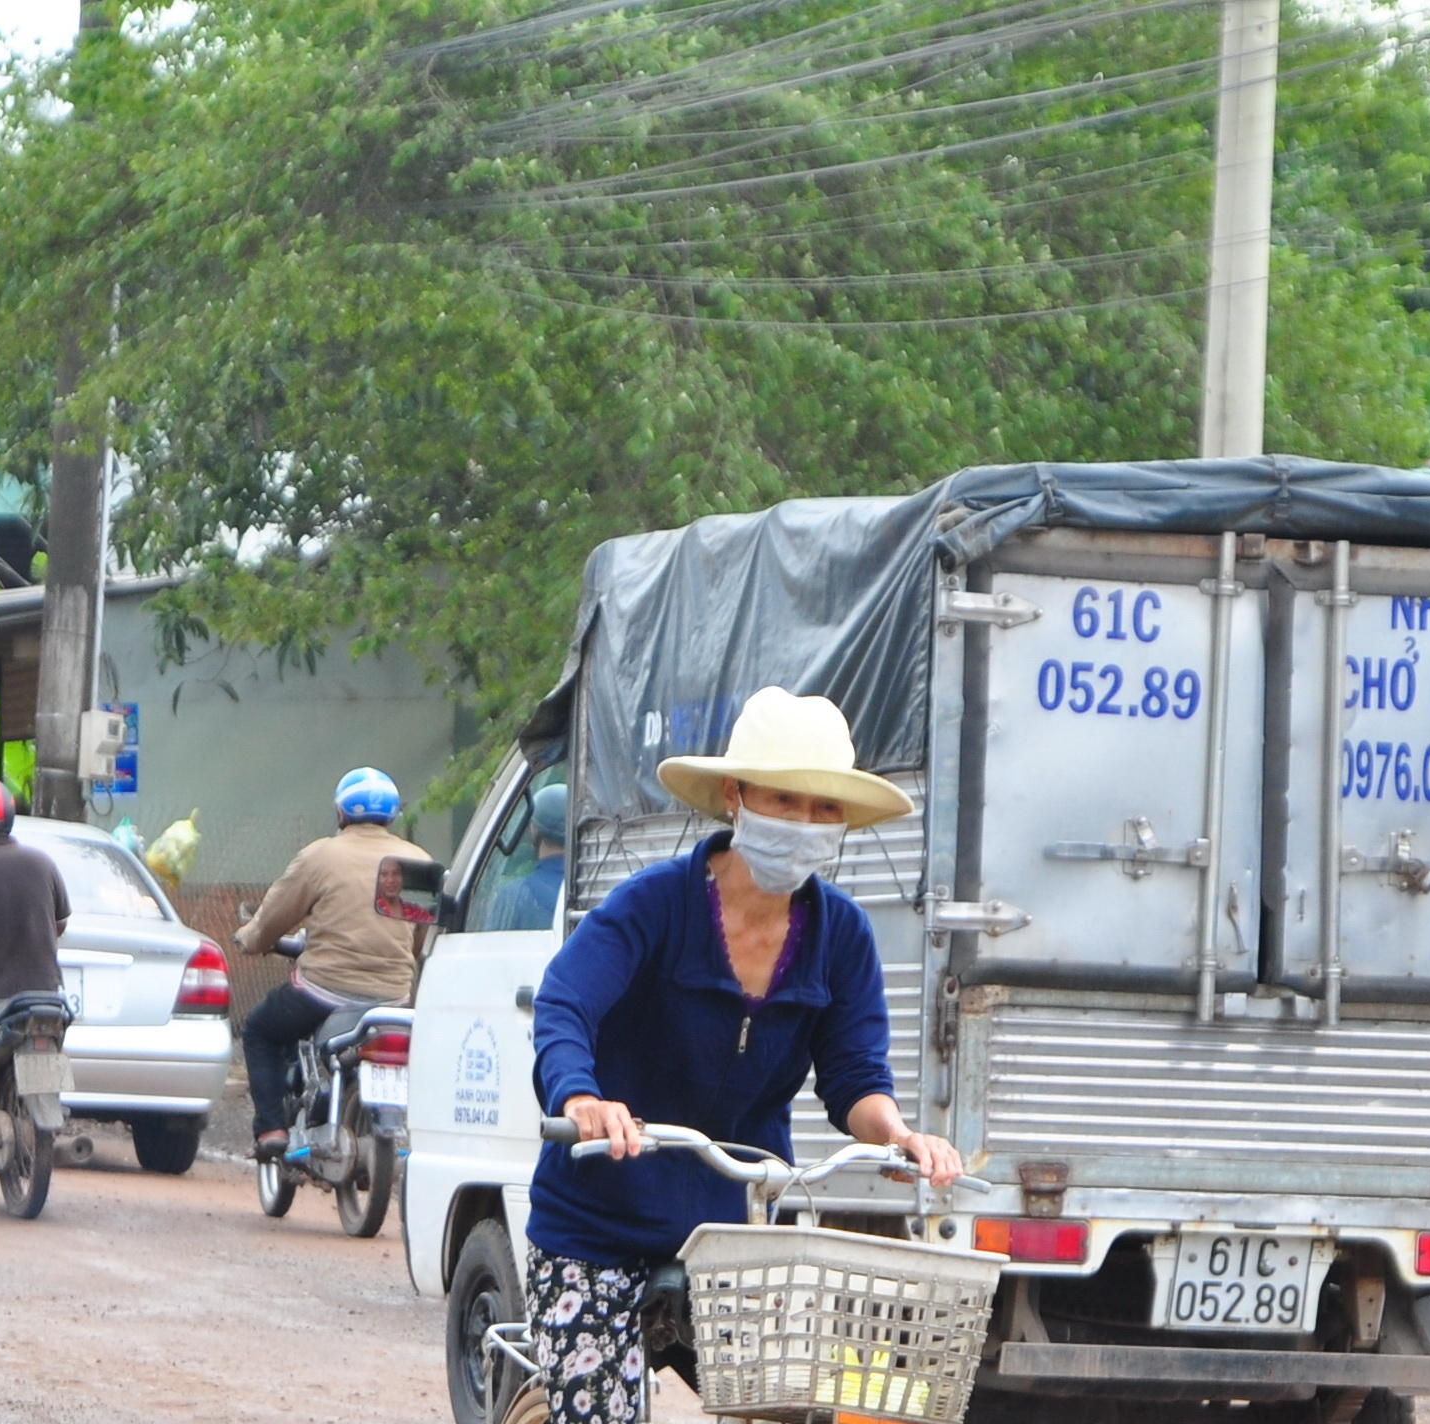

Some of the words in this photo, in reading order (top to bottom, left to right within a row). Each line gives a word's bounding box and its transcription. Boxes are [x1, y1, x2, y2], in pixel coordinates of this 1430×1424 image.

[1072, 585, 1162, 643] 61C
[1037, 658, 1202, 720] 052.89
[1208, 1235, 1280, 1278] 61C
[1175, 1280, 1301, 1325] 052.89
